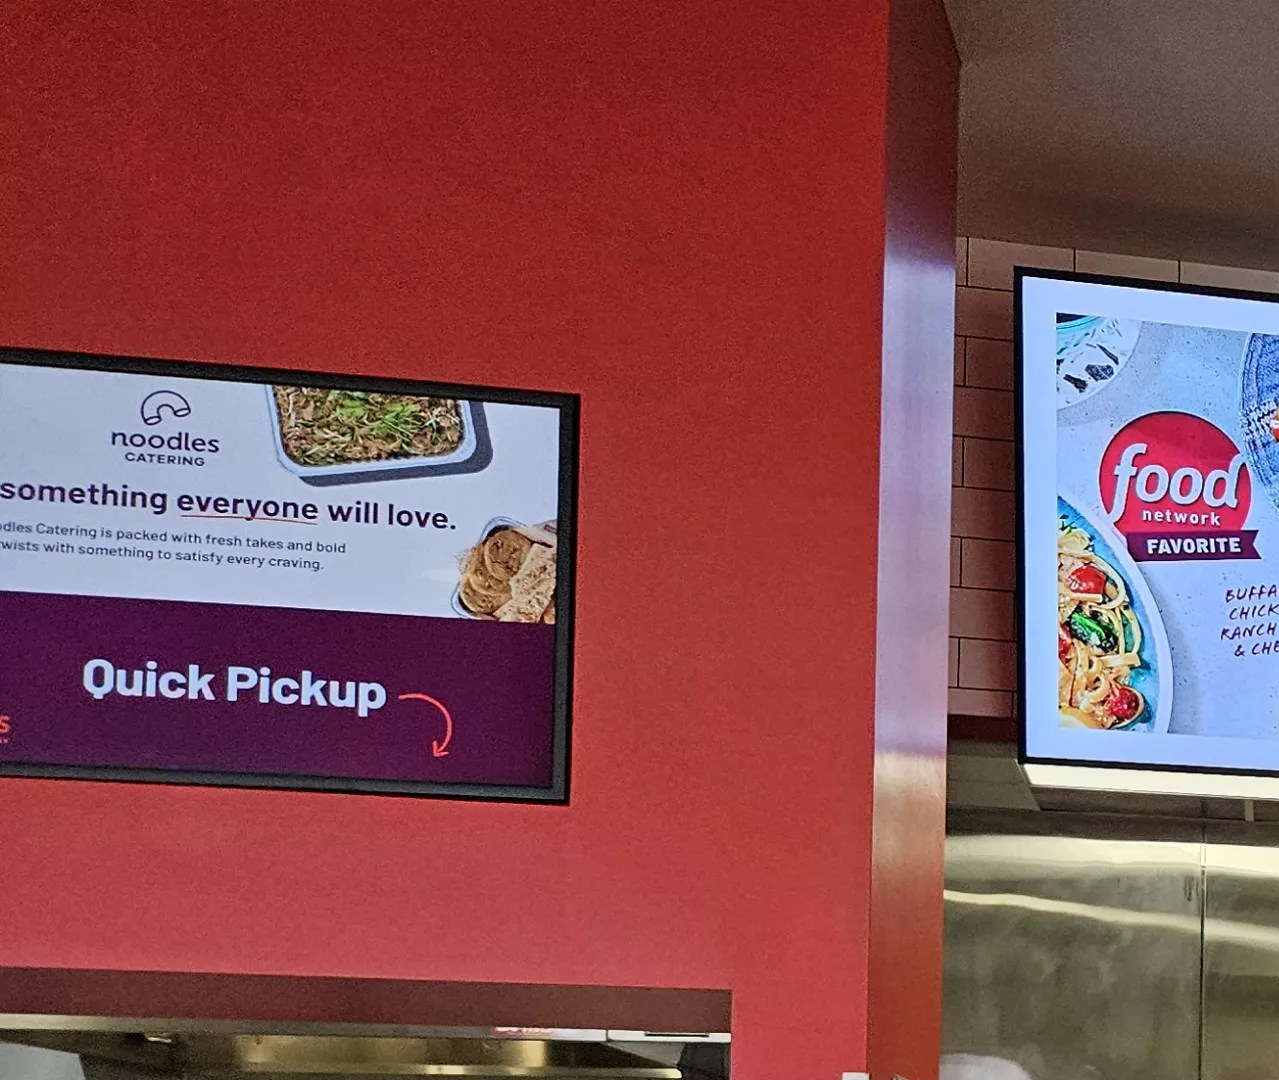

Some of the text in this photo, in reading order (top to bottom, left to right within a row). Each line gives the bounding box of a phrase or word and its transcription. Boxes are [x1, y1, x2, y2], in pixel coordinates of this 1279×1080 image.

[111, 431, 219, 453] noodles
[124, 452, 205, 466] CATERING
[1108, 443, 1246, 521] food
[0, 482, 456, 529] something everyone will love.
[1143, 508, 1221, 526] network
[35, 522, 97, 540] Catering
[100, 527, 112, 538] is
[116, 529, 167, 542] packed
[171, 532, 202, 544] with
[205, 533, 242, 546] fresh
[245, 537, 283, 549] takes
[286, 541, 312, 551] and
[316, 541, 346, 553] bold
[1146, 537, 1241, 554] FAVORITE
[43, 541, 74, 553] with
[78, 545, 153, 561] something
[157, 549, 172, 559] to
[175, 551, 223, 565] satisfy
[226, 555, 265, 568] every
[267, 557, 323, 572] craving.
[1220, 622, 1277, 640] RANCH
[1233, 644, 1245, 657] &
[82, 658, 386, 717] Quick Pickup
